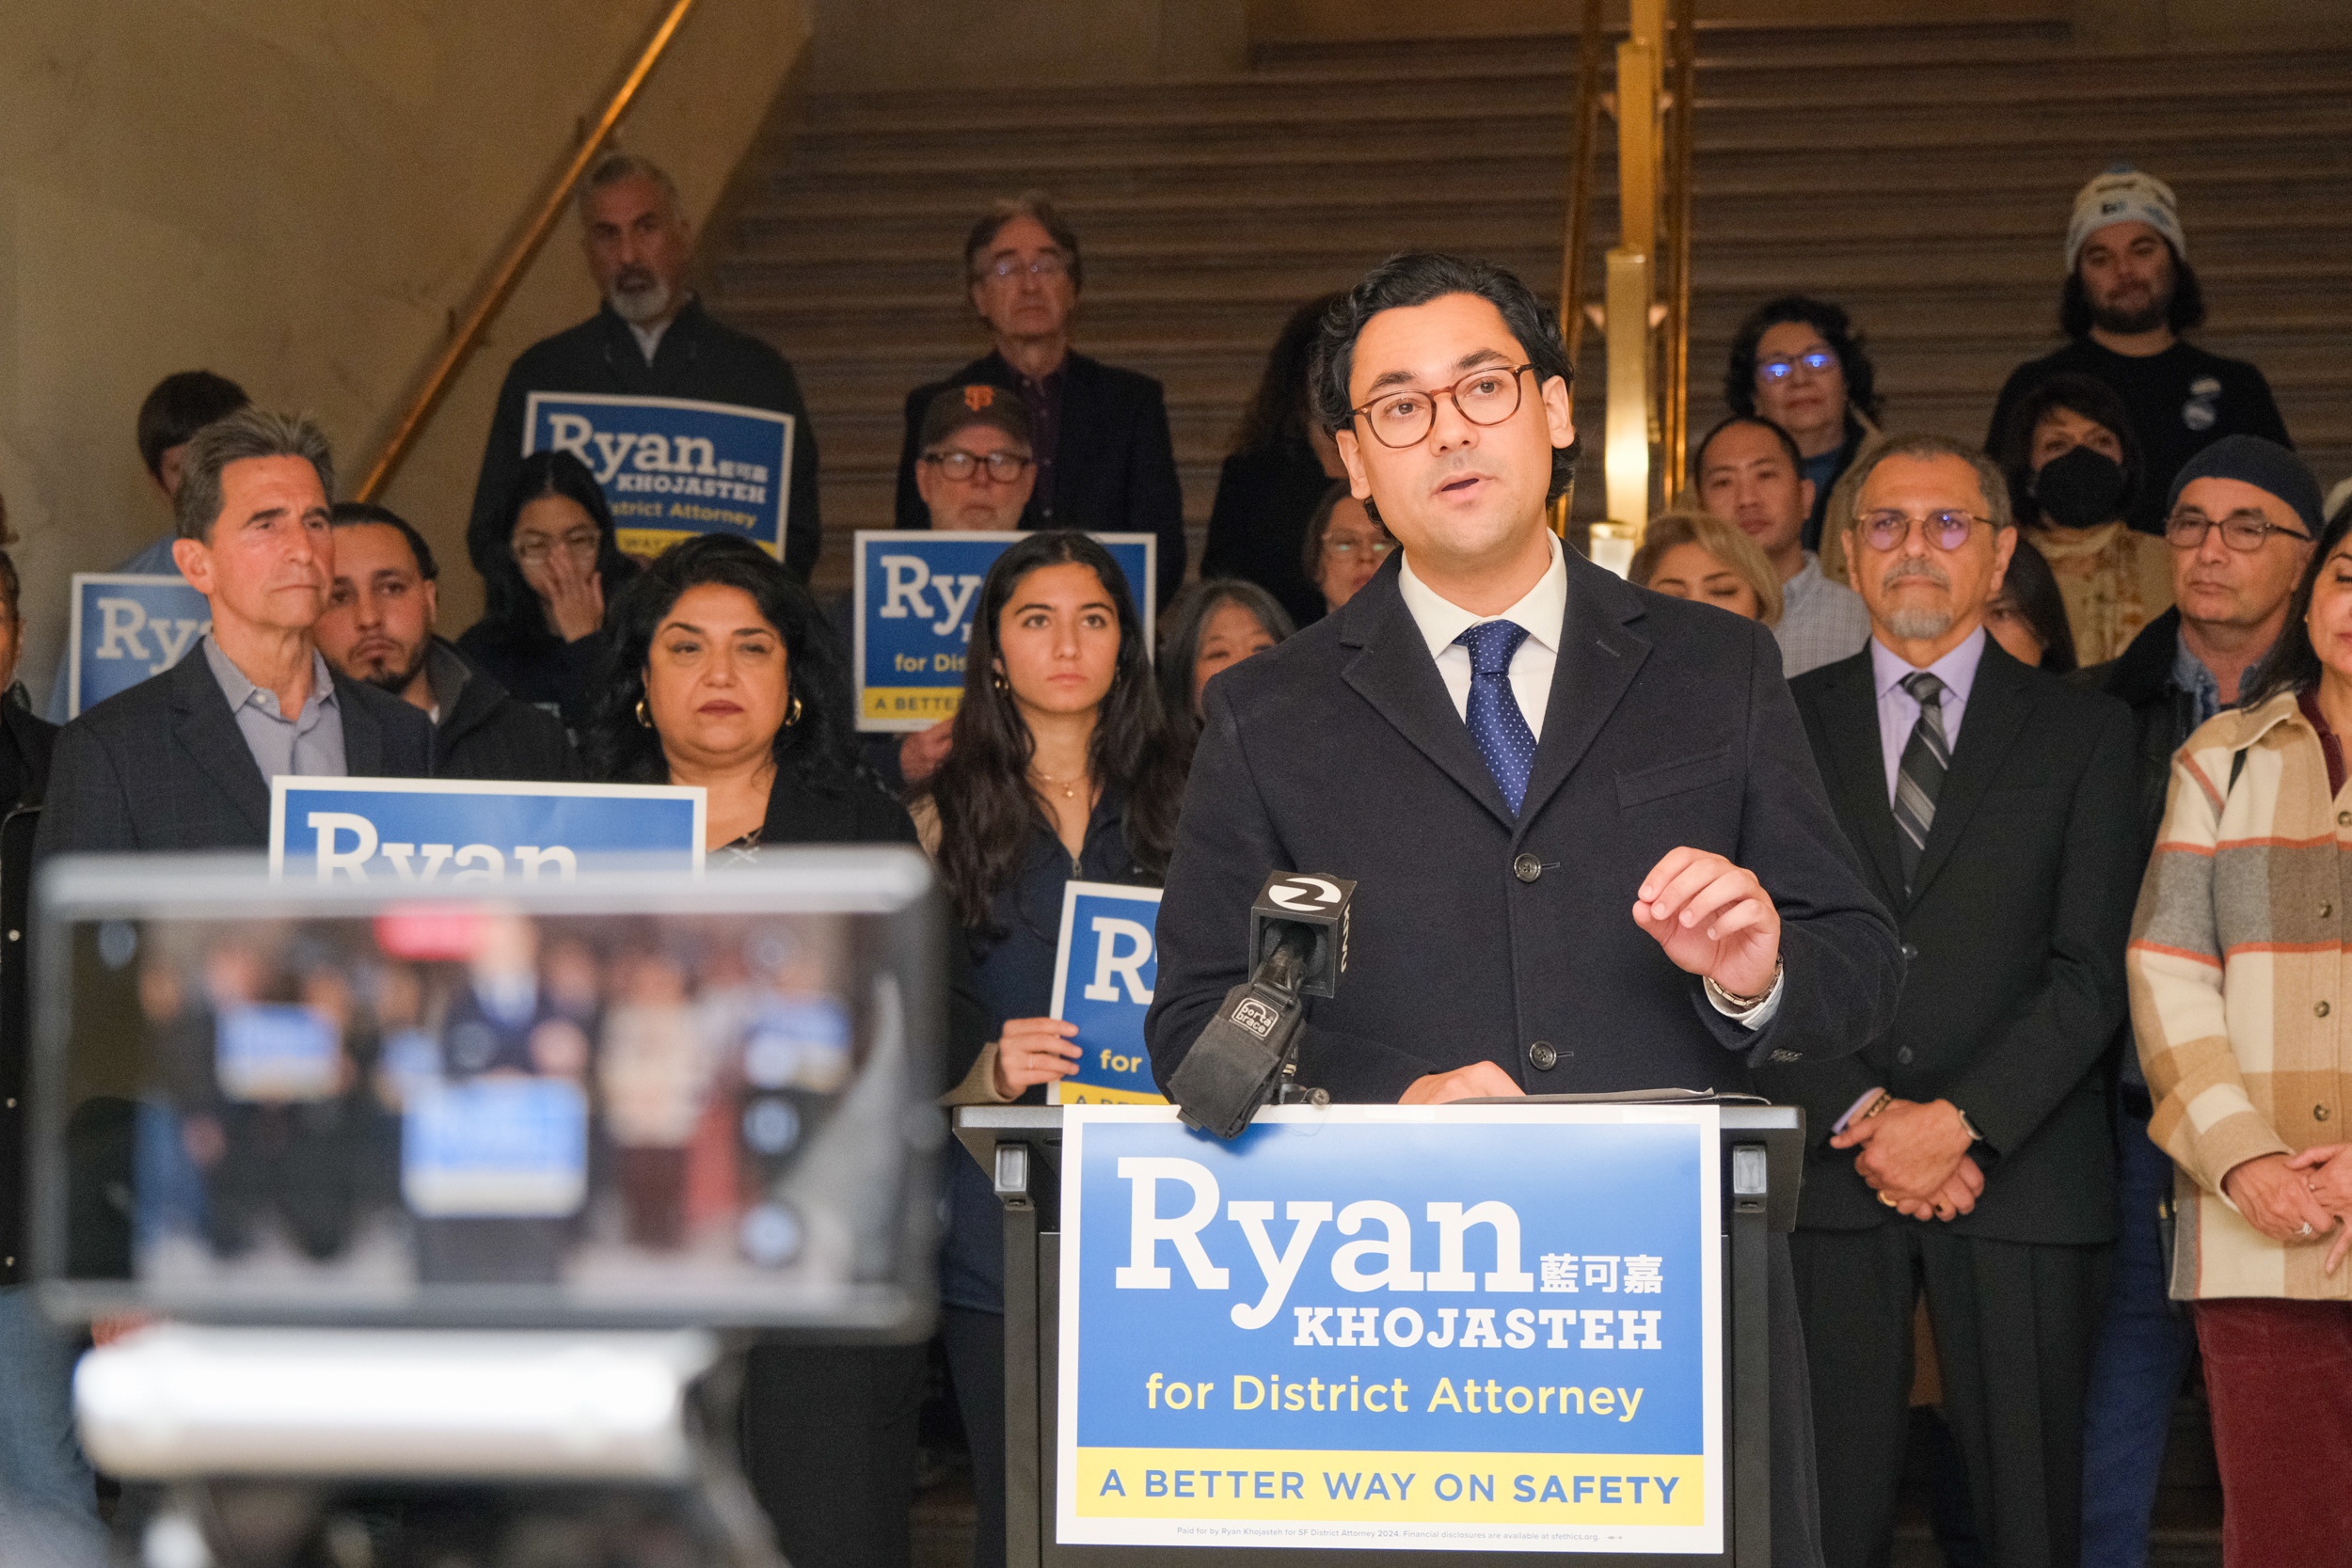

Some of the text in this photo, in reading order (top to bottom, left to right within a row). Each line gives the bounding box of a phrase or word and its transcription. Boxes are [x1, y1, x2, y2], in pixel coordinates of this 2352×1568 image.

[548, 414, 718, 484] Ryan
[96, 597, 214, 675] Ry
[895, 653, 928, 672] for
[895, 697, 961, 712] BETTE
[1268, 877, 1342, 911] 2
[1084, 916, 1158, 1006] R
[1235, 1010, 1266, 1034] brace
[1241, 1004, 1272, 1027] porta
[1100, 1049, 1142, 1072] for
[1115, 1157, 1534, 1330] Ryan
[1540, 1253, 1663, 1293] 藍可嘉
[1294, 1307, 1662, 1350] KHOJASTEH
[1146, 1372, 1645, 1423] for District Attorney
[1099, 1468, 1680, 1505] A BETTER WAY ON SAFETY
[1209, 1528, 1219, 1536] by
[1221, 1528, 1241, 1536] Ryan
[1243, 1528, 1283, 1537] Khojasteh
[1341, 1528, 1375, 1538] Attorney
[1377, 1529, 1402, 1538] 2024.
[1440, 1530, 1486, 1539] disclosures
[1502, 1531, 1539, 1540] available
[1550, 1532, 1600, 1542] sfethics.org.
